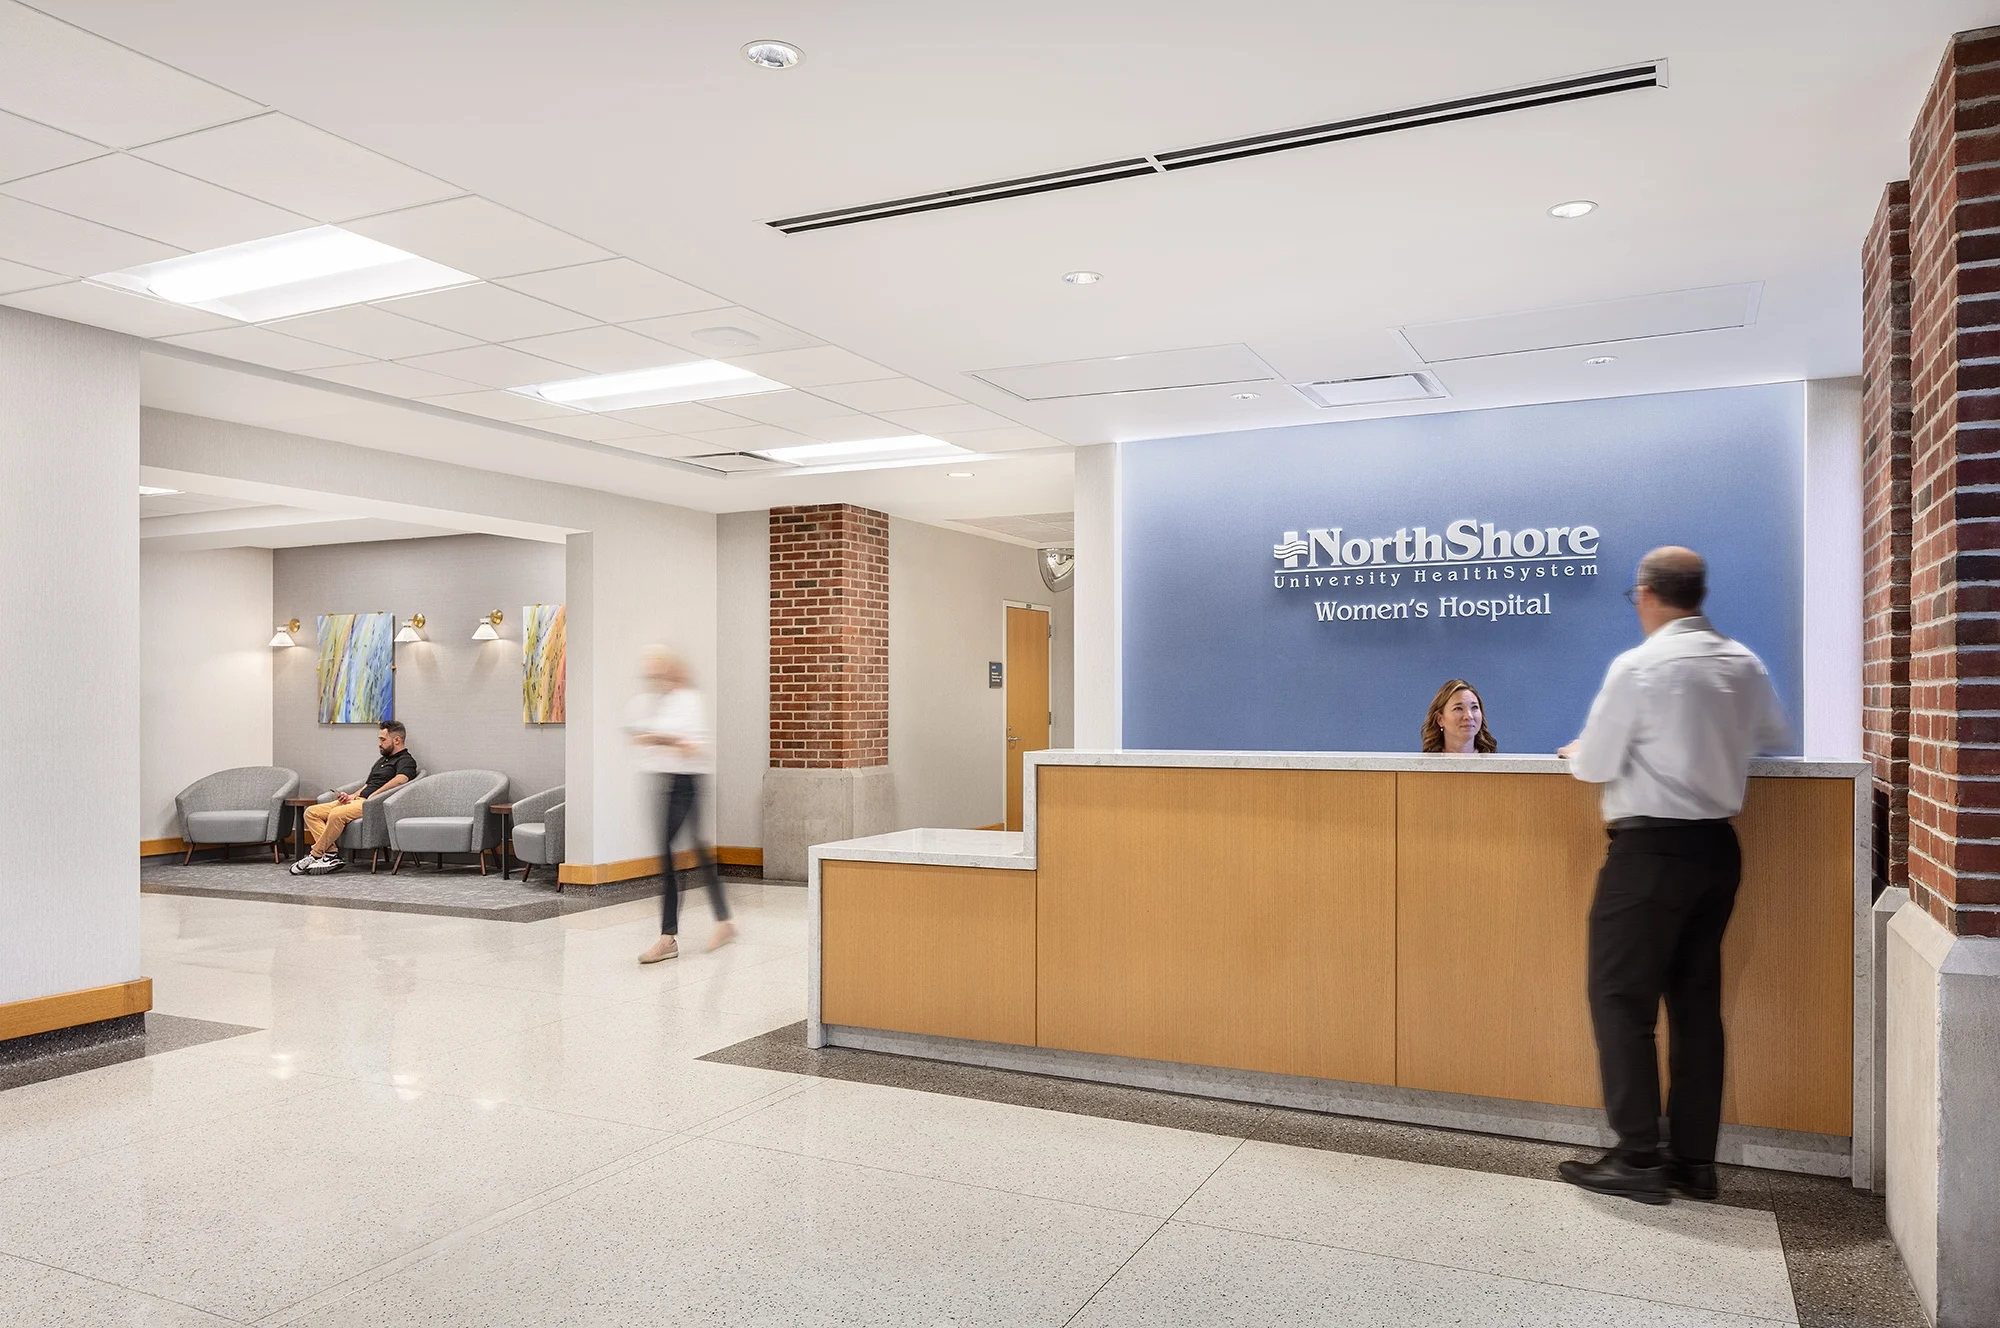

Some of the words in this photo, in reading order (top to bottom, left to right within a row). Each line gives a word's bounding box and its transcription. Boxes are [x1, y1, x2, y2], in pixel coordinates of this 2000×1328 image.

[1307, 519, 1600, 567] NorthShore
[1273, 571, 1401, 589] University
[1414, 563, 1598, 583] HealthSystem
[1314, 598, 1429, 622] Women's
[1438, 593, 1552, 622] Hospital
